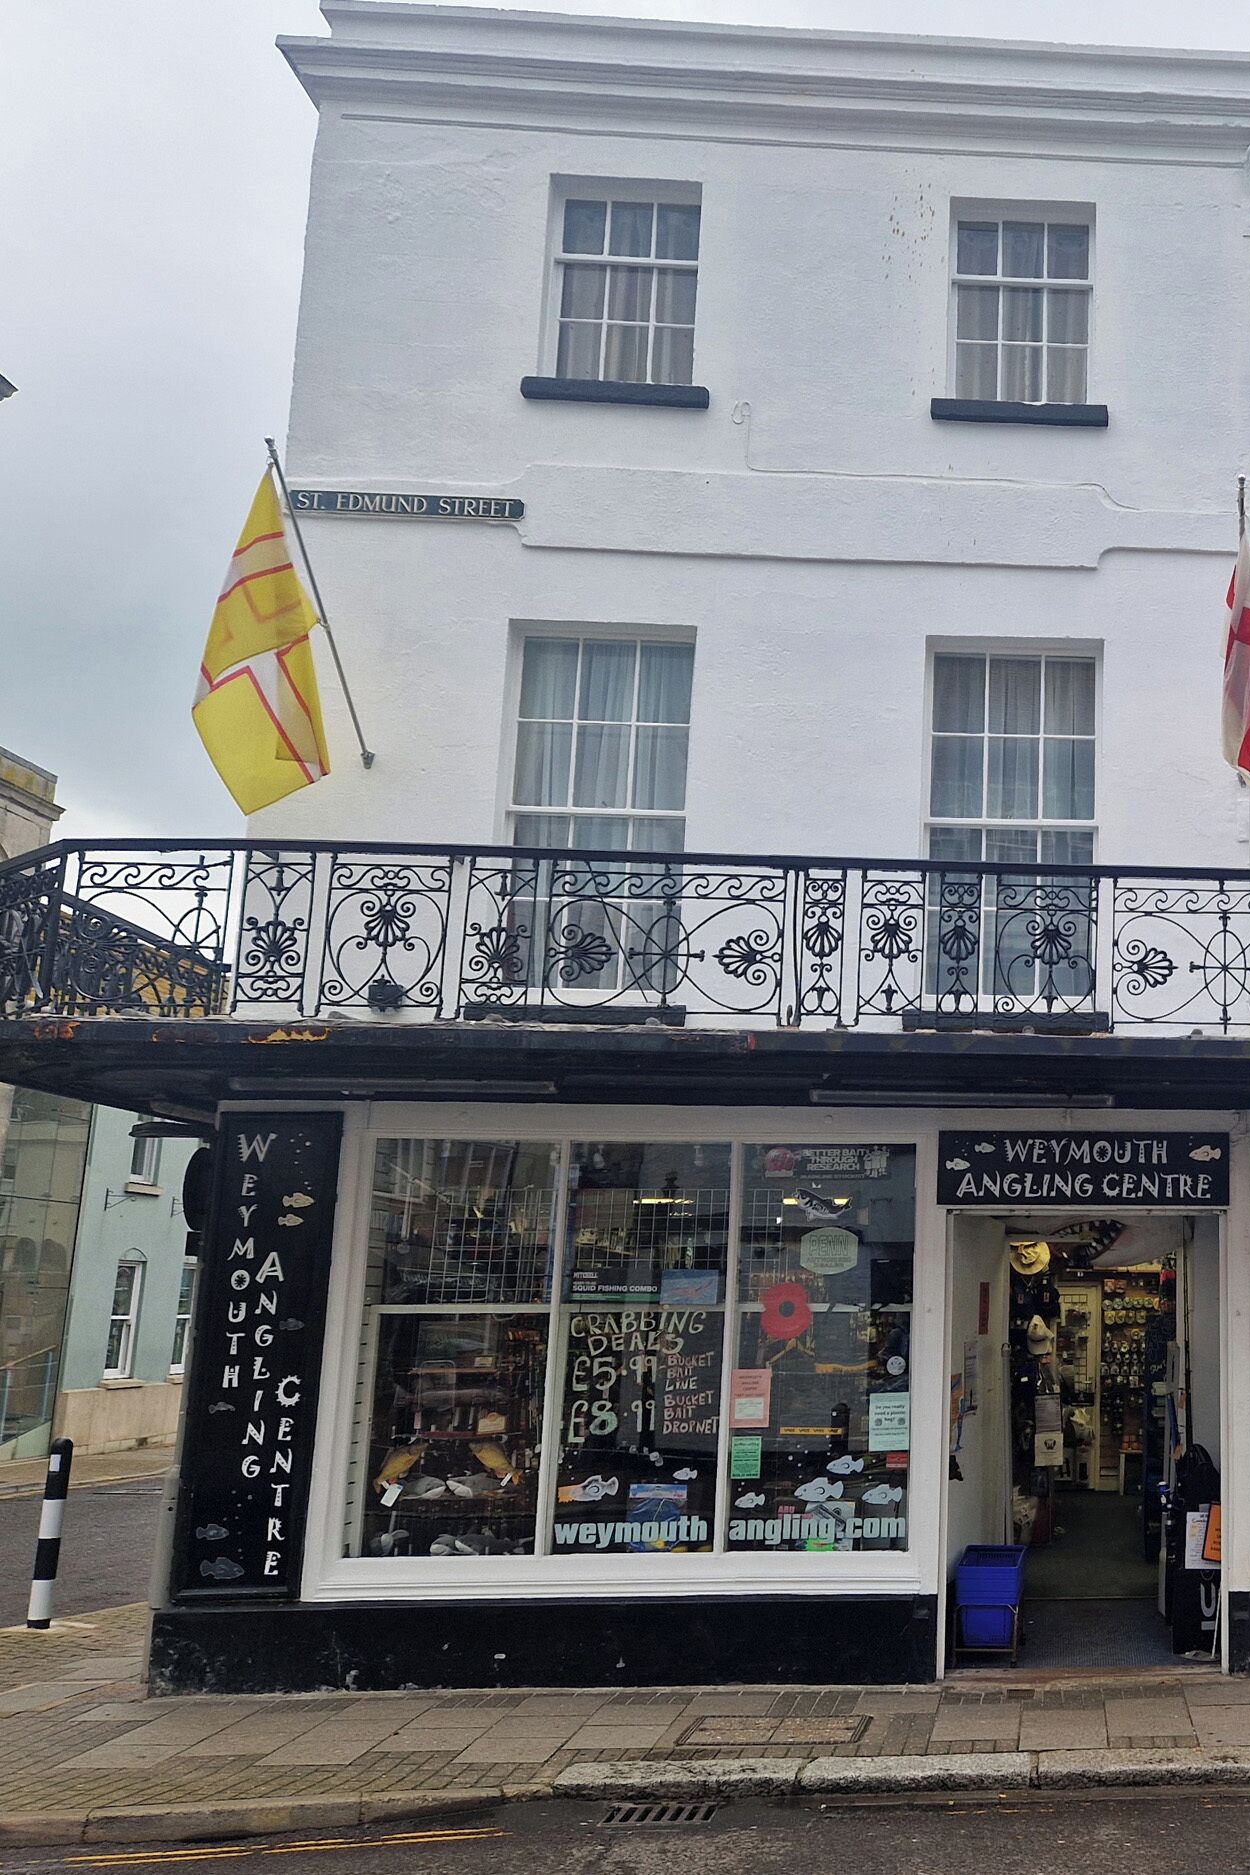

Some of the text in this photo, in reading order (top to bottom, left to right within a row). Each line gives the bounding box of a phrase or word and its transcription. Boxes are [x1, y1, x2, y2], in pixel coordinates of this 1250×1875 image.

[296, 492, 514, 518] ST. EDMUND STREET
[801, 1149, 840, 1157] BETTER
[810, 1156, 858, 1164] THROUGH
[1003, 1137, 1168, 1165] WEYMOUTH
[806, 1163, 860, 1171] RESEARCH
[956, 1170, 1212, 1199] ANGLING CENTRE
[809, 1235, 849, 1257] PENN
[222, 1133, 278, 1389] WEYMOUTH
[571, 1310, 707, 1337] CRABBING
[587, 1331, 684, 1356] DEALS
[241, 1251, 285, 1479] ANGLING
[572, 1352, 715, 1391] £5.99 BUCKET
[568, 1391, 715, 1443] £8.99 BUCKET
[263, 1375, 301, 1577] CENTRE
[554, 1514, 907, 1548] weymouth angling.com
